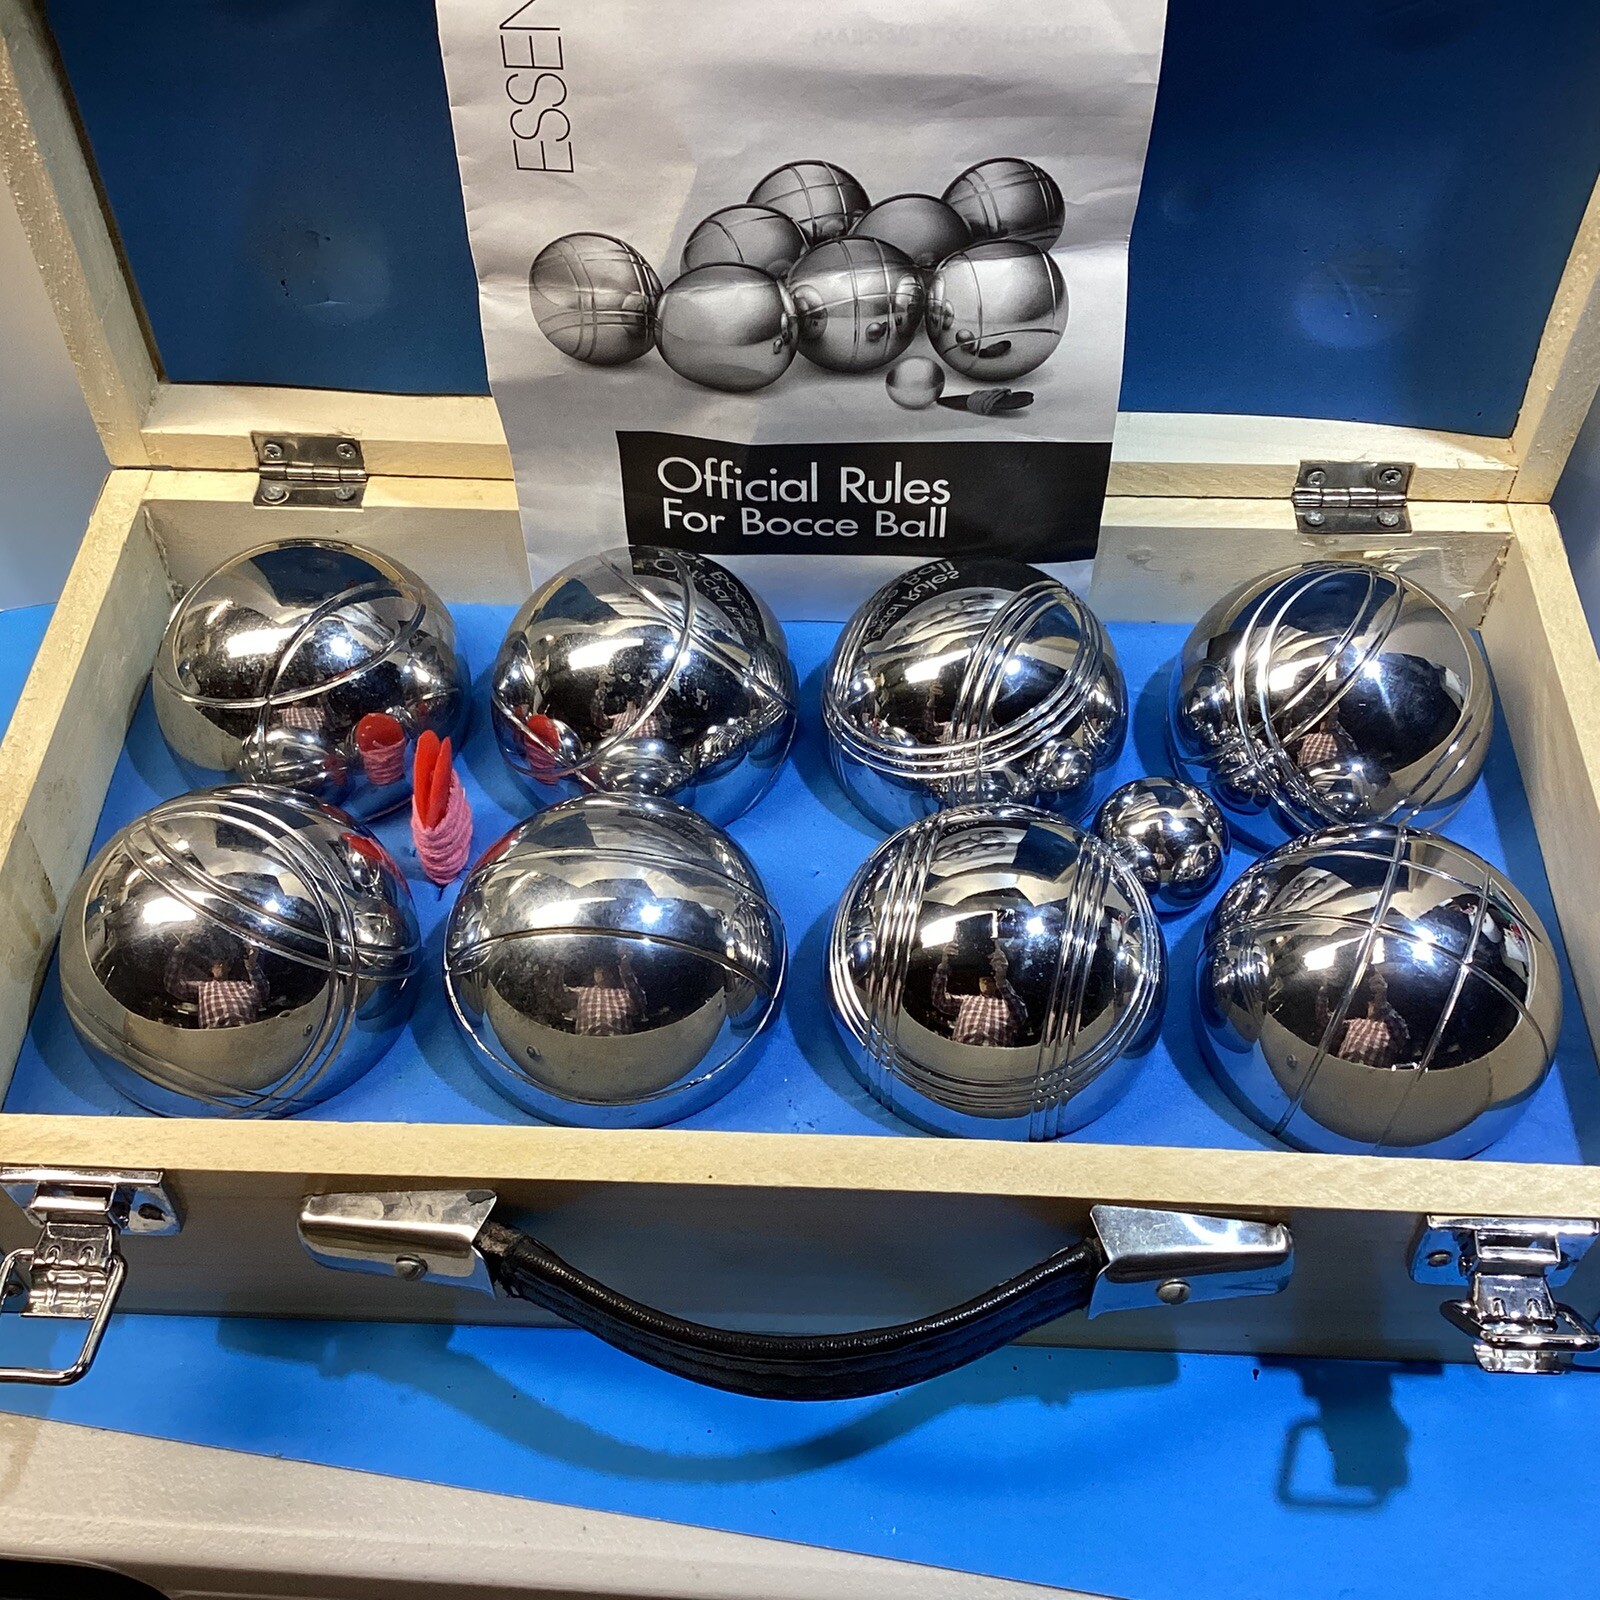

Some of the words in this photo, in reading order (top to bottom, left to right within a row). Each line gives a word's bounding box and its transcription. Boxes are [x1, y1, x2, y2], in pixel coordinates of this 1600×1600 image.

[657, 456, 818, 503] Official
[840, 461, 951, 504] Rules
[663, 497, 726, 534] For
[741, 507, 859, 537] Bocce
[875, 506, 947, 538] Ball
